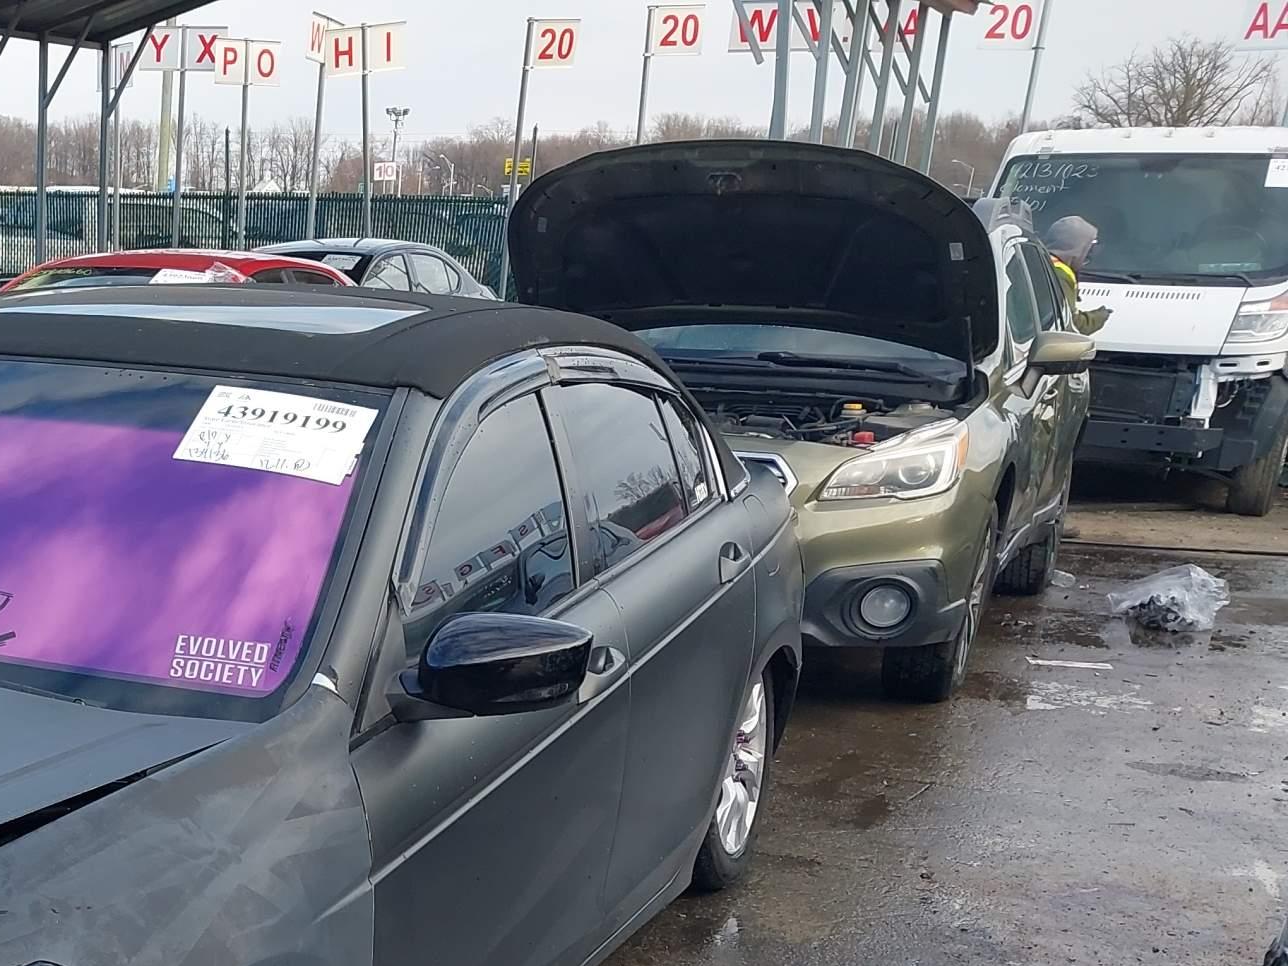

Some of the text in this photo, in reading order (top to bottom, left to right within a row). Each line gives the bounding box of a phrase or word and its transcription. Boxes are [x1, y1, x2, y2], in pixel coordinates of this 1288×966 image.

[660, 14, 699, 46] 20
[984, 4, 1032, 40] 20
[151, 34, 218, 63] Y X
[334, 36, 353, 68] H
[538, 28, 574, 59] 20
[223, 47, 238, 75] P
[217, 404, 347, 433] 43919199
[175, 635, 269, 663] EVOLVED
[170, 658, 263, 687] SOCIETY
